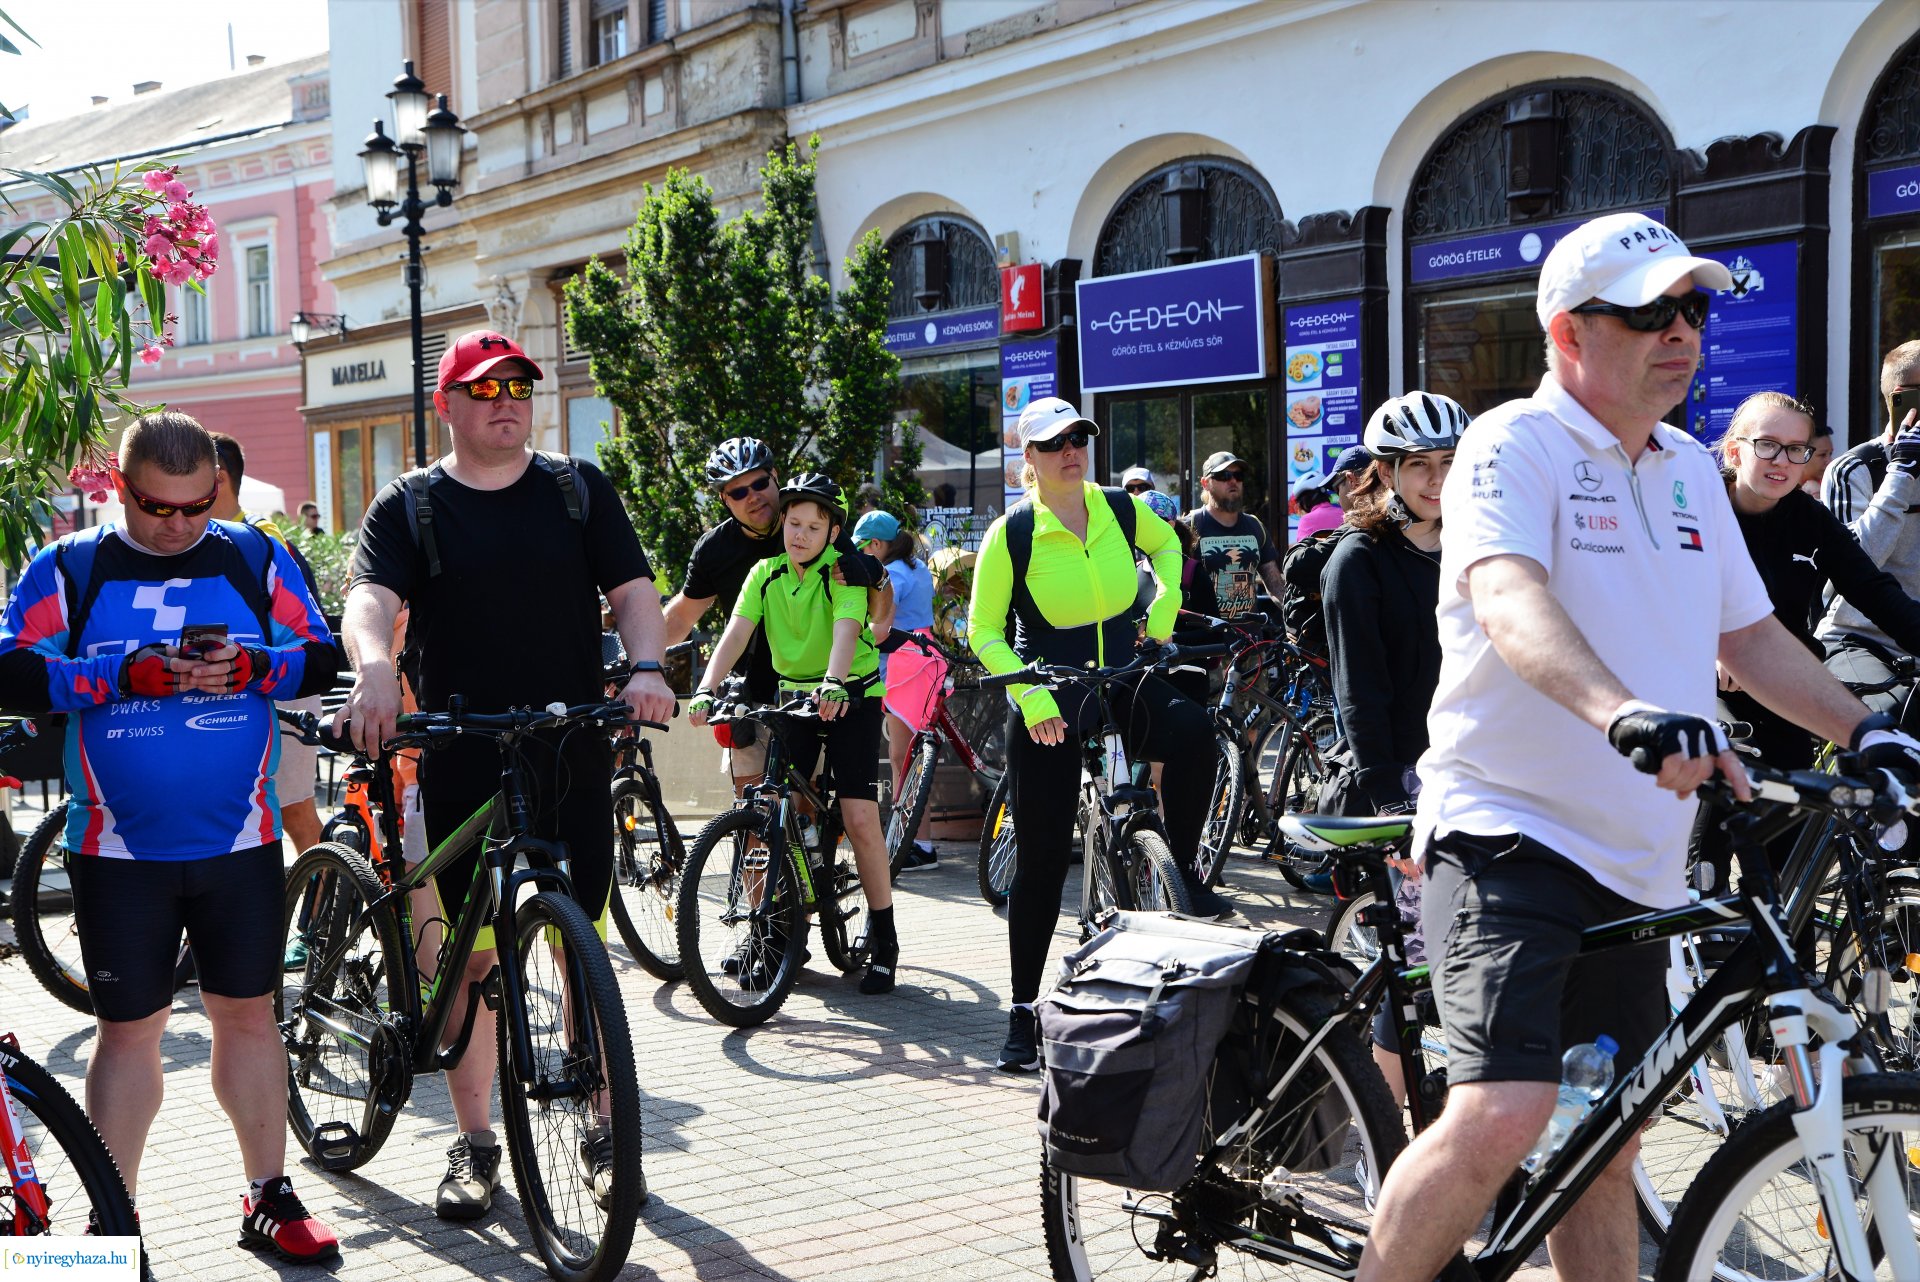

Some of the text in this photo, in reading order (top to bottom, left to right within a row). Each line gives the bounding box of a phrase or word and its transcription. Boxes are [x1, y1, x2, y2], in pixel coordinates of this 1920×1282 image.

[1896, 180, 1920, 198] GÖ
[1428, 247, 1502, 268] GÖRÖG ÉTELEK
[1108, 298, 1223, 335] GEDEON
[1297, 312, 1347, 328] GEDEON
[1112, 345, 1137, 357] GÖRÖG
[1138, 342, 1155, 354] ÉTEL
[1157, 342, 1164, 351] &
[1165, 337, 1204, 350] KÉZMŰVES
[1010, 349, 1047, 362] GEDEON
[331, 360, 386, 386] MARELLA
[926, 506, 973, 522] pilsner
[1588, 515, 1618, 531] UBS
[1570, 537, 1626, 554] Qualcomm
[181, 692, 248, 705] Syntace
[111, 699, 161, 716] DWRKS
[198, 714, 249, 726] SCHWALBE
[106, 726, 164, 739] DT SWISS
[1632, 926, 1656, 940] LIFE
[1620, 1021, 1689, 1122] KTM
